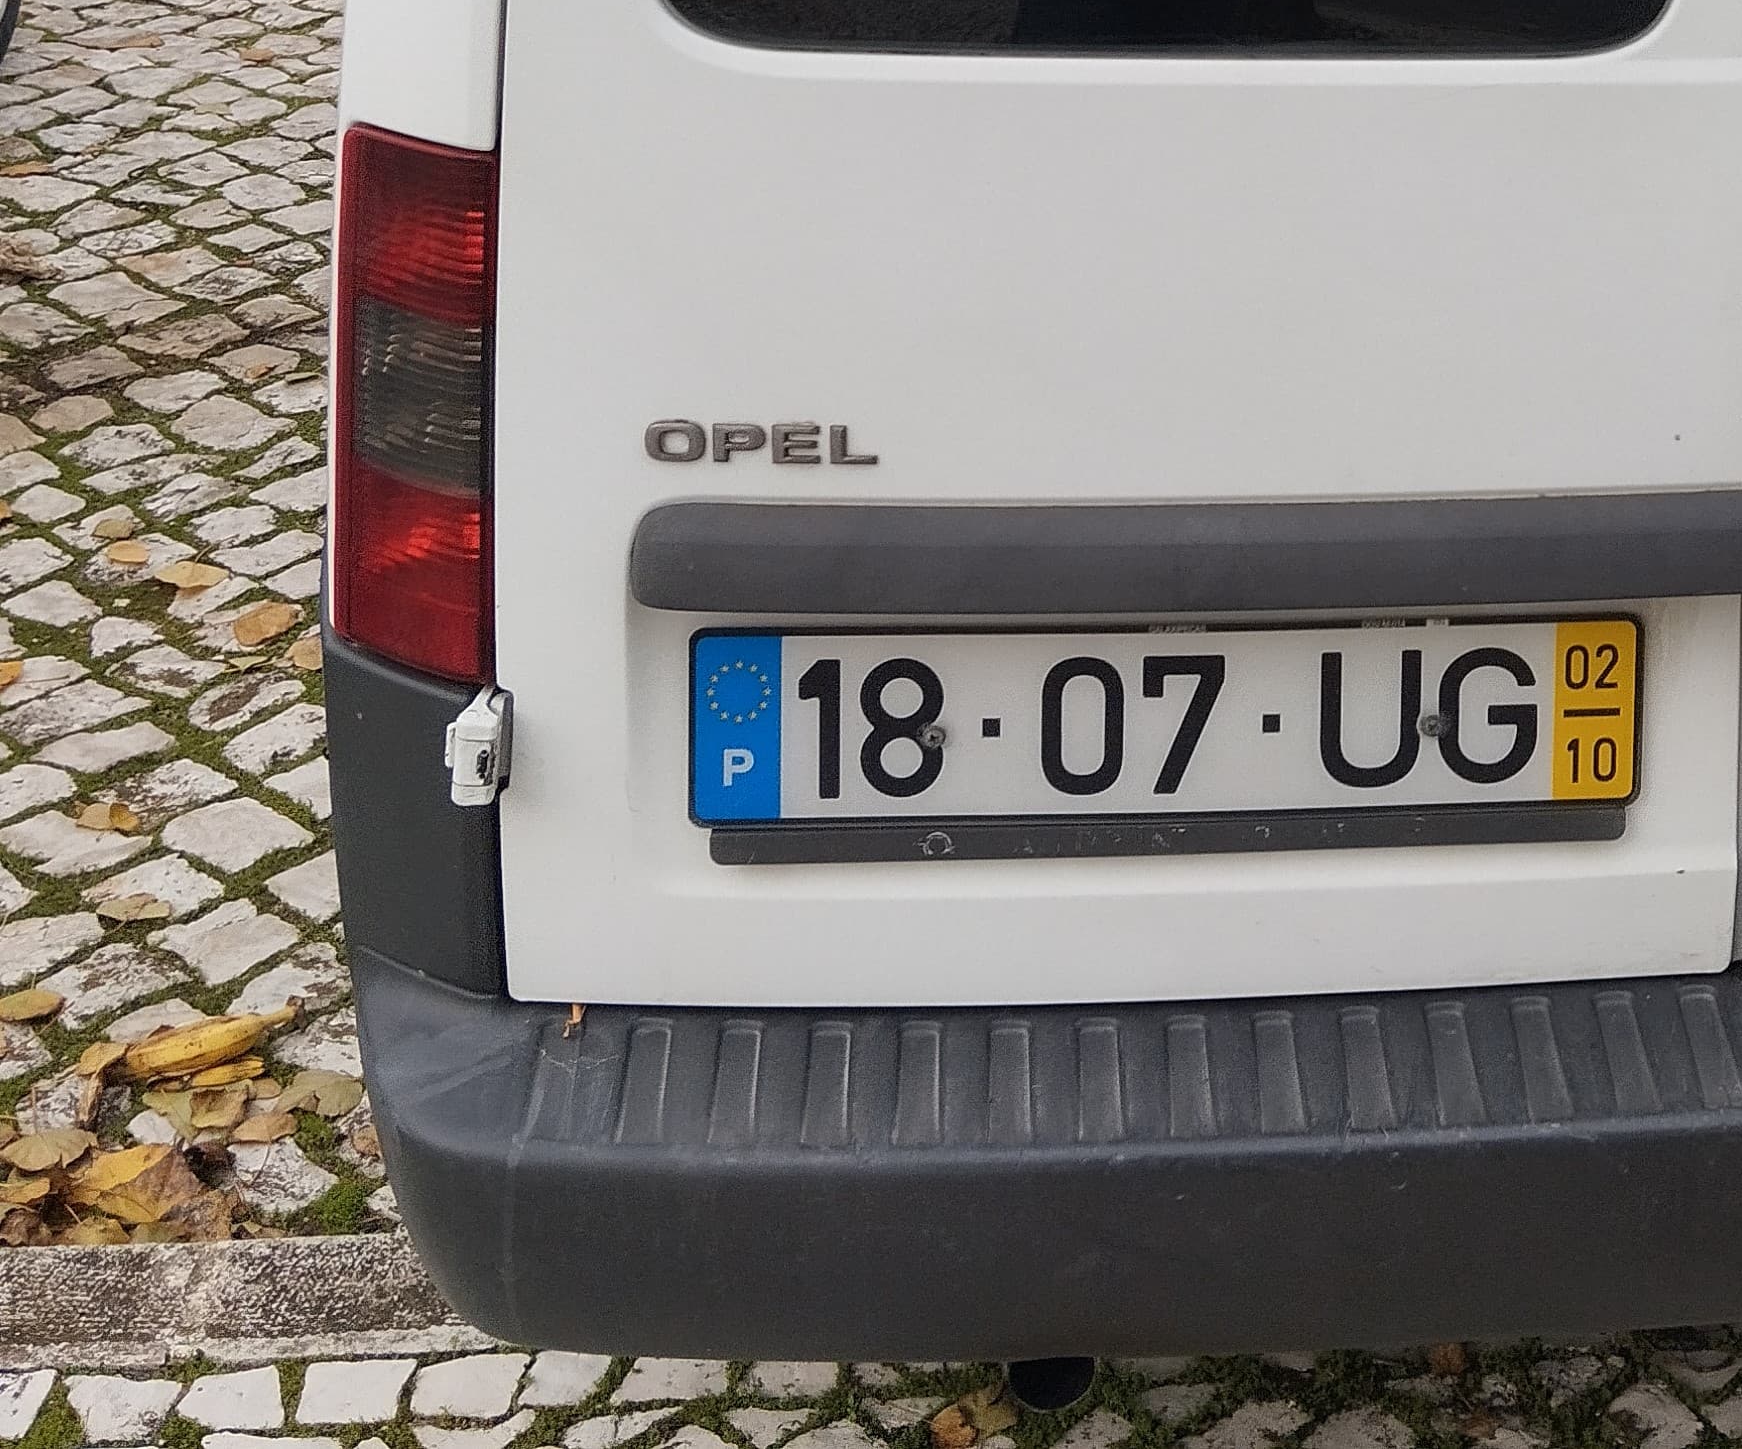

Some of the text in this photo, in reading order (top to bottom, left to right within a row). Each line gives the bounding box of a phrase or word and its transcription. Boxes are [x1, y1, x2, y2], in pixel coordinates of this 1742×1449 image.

[644, 418, 880, 466] OPEL
[1564, 643, 1620, 690] 02
[722, 748, 755, 787] P
[1566, 737, 1618, 784] 10
